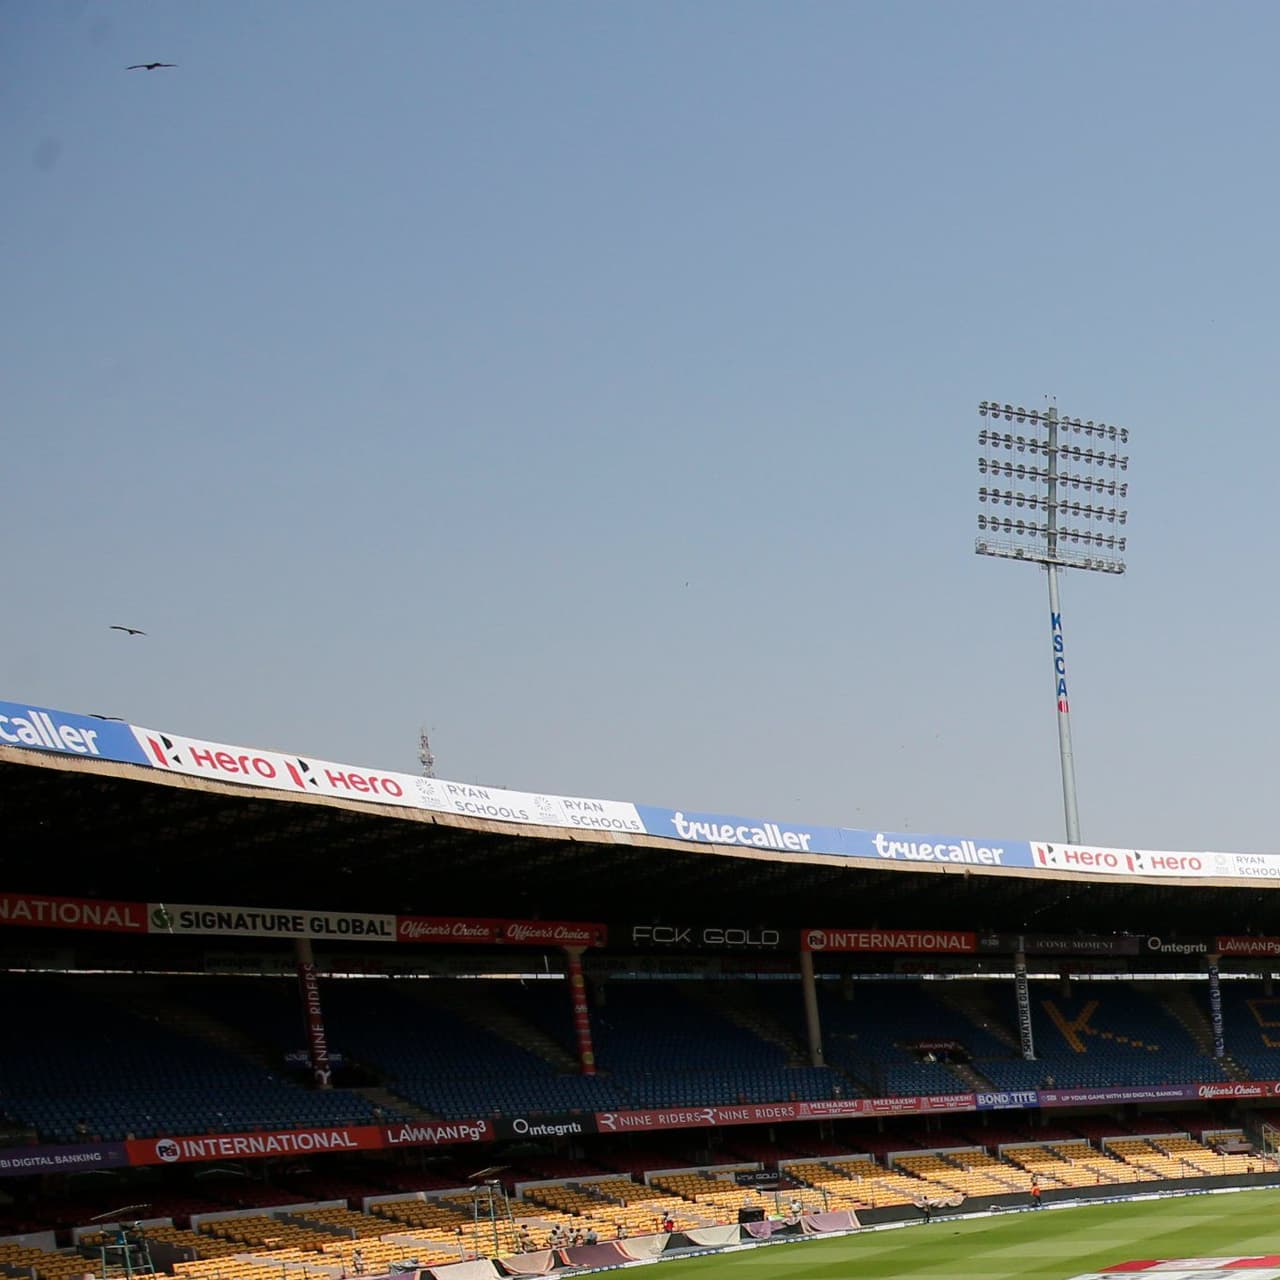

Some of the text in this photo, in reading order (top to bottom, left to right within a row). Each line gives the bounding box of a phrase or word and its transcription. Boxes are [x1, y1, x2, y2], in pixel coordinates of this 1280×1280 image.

[1051, 612, 1067, 697] KSCA
[192, 745, 277, 779] Hero
[325, 769, 403, 798] Hero
[447, 784, 489, 800] RYAN
[455, 801, 529, 820] SCHOOLS
[564, 800, 604, 813] RYAN
[571, 815, 640, 831] SCHOOLS
[670, 812, 811, 851] truecaller
[871, 832, 1003, 866] truecaller
[1065, 849, 1118, 868] Hero
[1151, 855, 1202, 871] Hero
[1236, 856, 1265, 865] RYAN
[180, 911, 392, 937] SIGNATURE GLOBAL
[400, 921, 490, 938] Officer's Choice
[507, 924, 590, 940] Officer's Choice
[632, 926, 779, 945] FCK GOLD
[829, 933, 971, 949] INTERNATIONAL
[1072, 941, 1114, 950] MOMENT
[978, 1094, 1007, 1105] BOND
[1011, 1092, 1036, 1103] TITE
[1199, 1085, 1261, 1099] Officer's Choice
[620, 1111, 700, 1127] NINE RIDERS
[718, 1106, 796, 1122] NINE RIDERS
[387, 1124, 458, 1145] LAWMAN
[183, 1131, 358, 1158] INTERNATIONAL
[13, 1152, 102, 1168] DIGITAL BANKING
